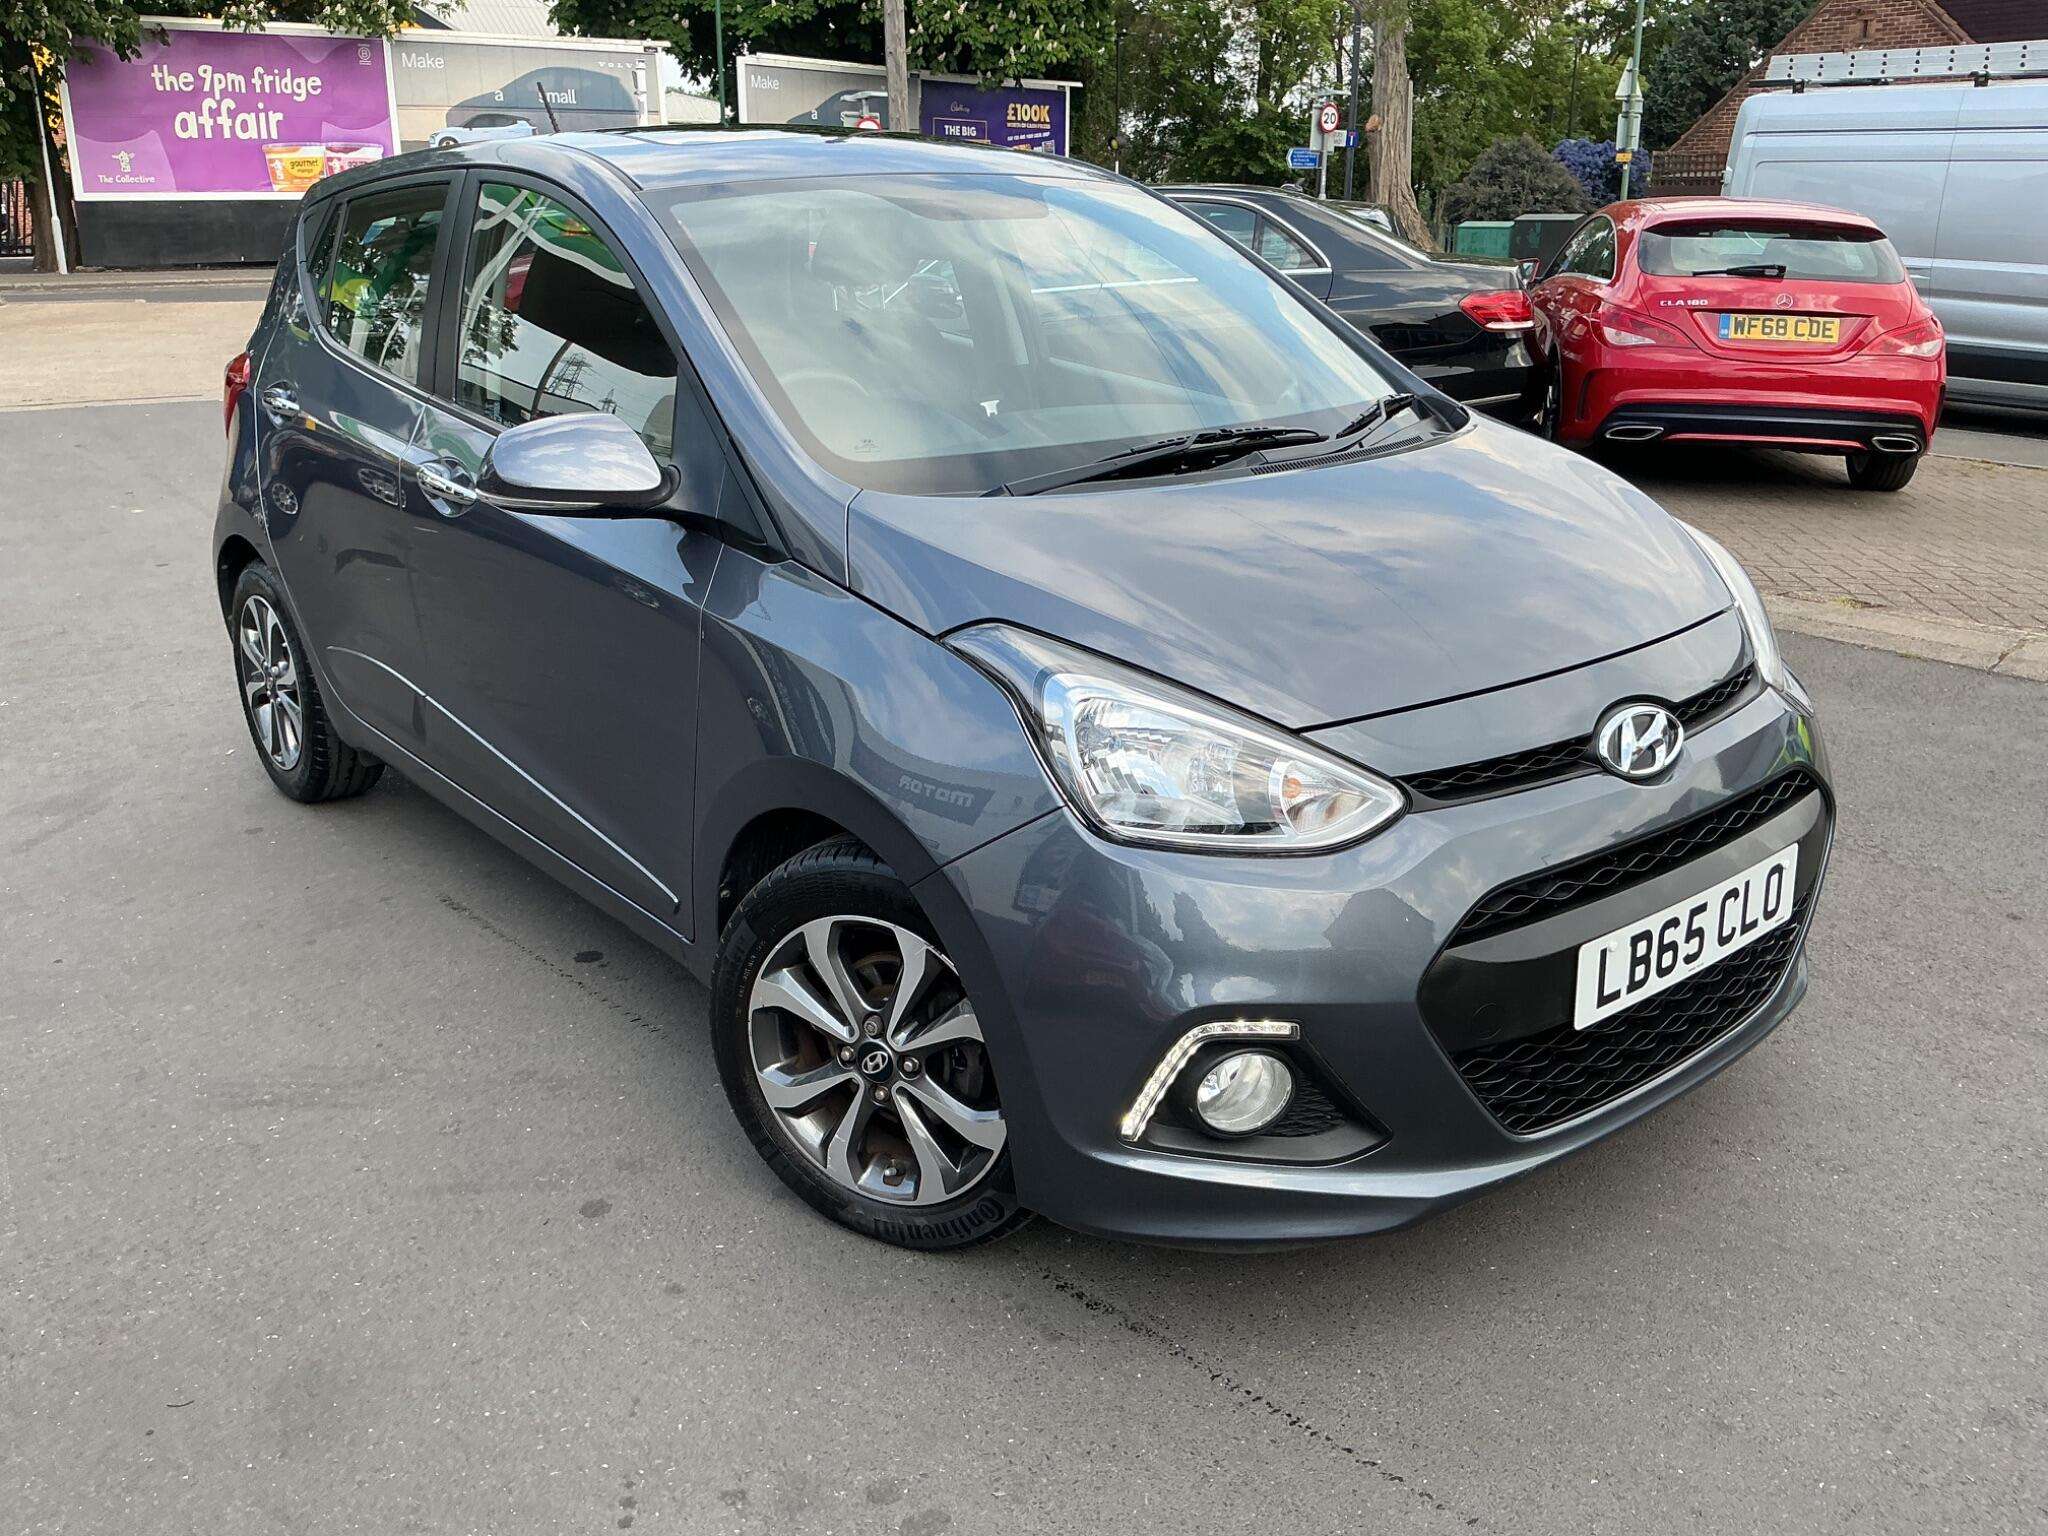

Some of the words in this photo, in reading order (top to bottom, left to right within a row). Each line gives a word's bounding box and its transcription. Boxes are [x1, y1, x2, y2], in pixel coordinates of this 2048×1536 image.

[401, 52, 445, 69] Make
[151, 64, 195, 92] the
[197, 64, 246, 101] 9pm
[251, 66, 322, 102] fridge
[751, 74, 780, 90] Make
[494, 91, 504, 102] a
[174, 97, 284, 140] affair
[810, 109, 818, 120] a
[1006, 102, 1051, 122] £100K
[1323, 112, 1337, 125] 20
[944, 124, 961, 136] THE
[961, 125, 977, 137] BIG
[97, 174, 114, 184] The
[115, 174, 156, 184] Collective
[1659, 299, 1685, 307] CLA
[1686, 299, 1709, 307] 180
[1733, 316, 1788, 337] WF68
[1793, 318, 1836, 340] CDE
[1596, 900, 1709, 1010] LB65
[1716, 862, 1784, 947] CLO
